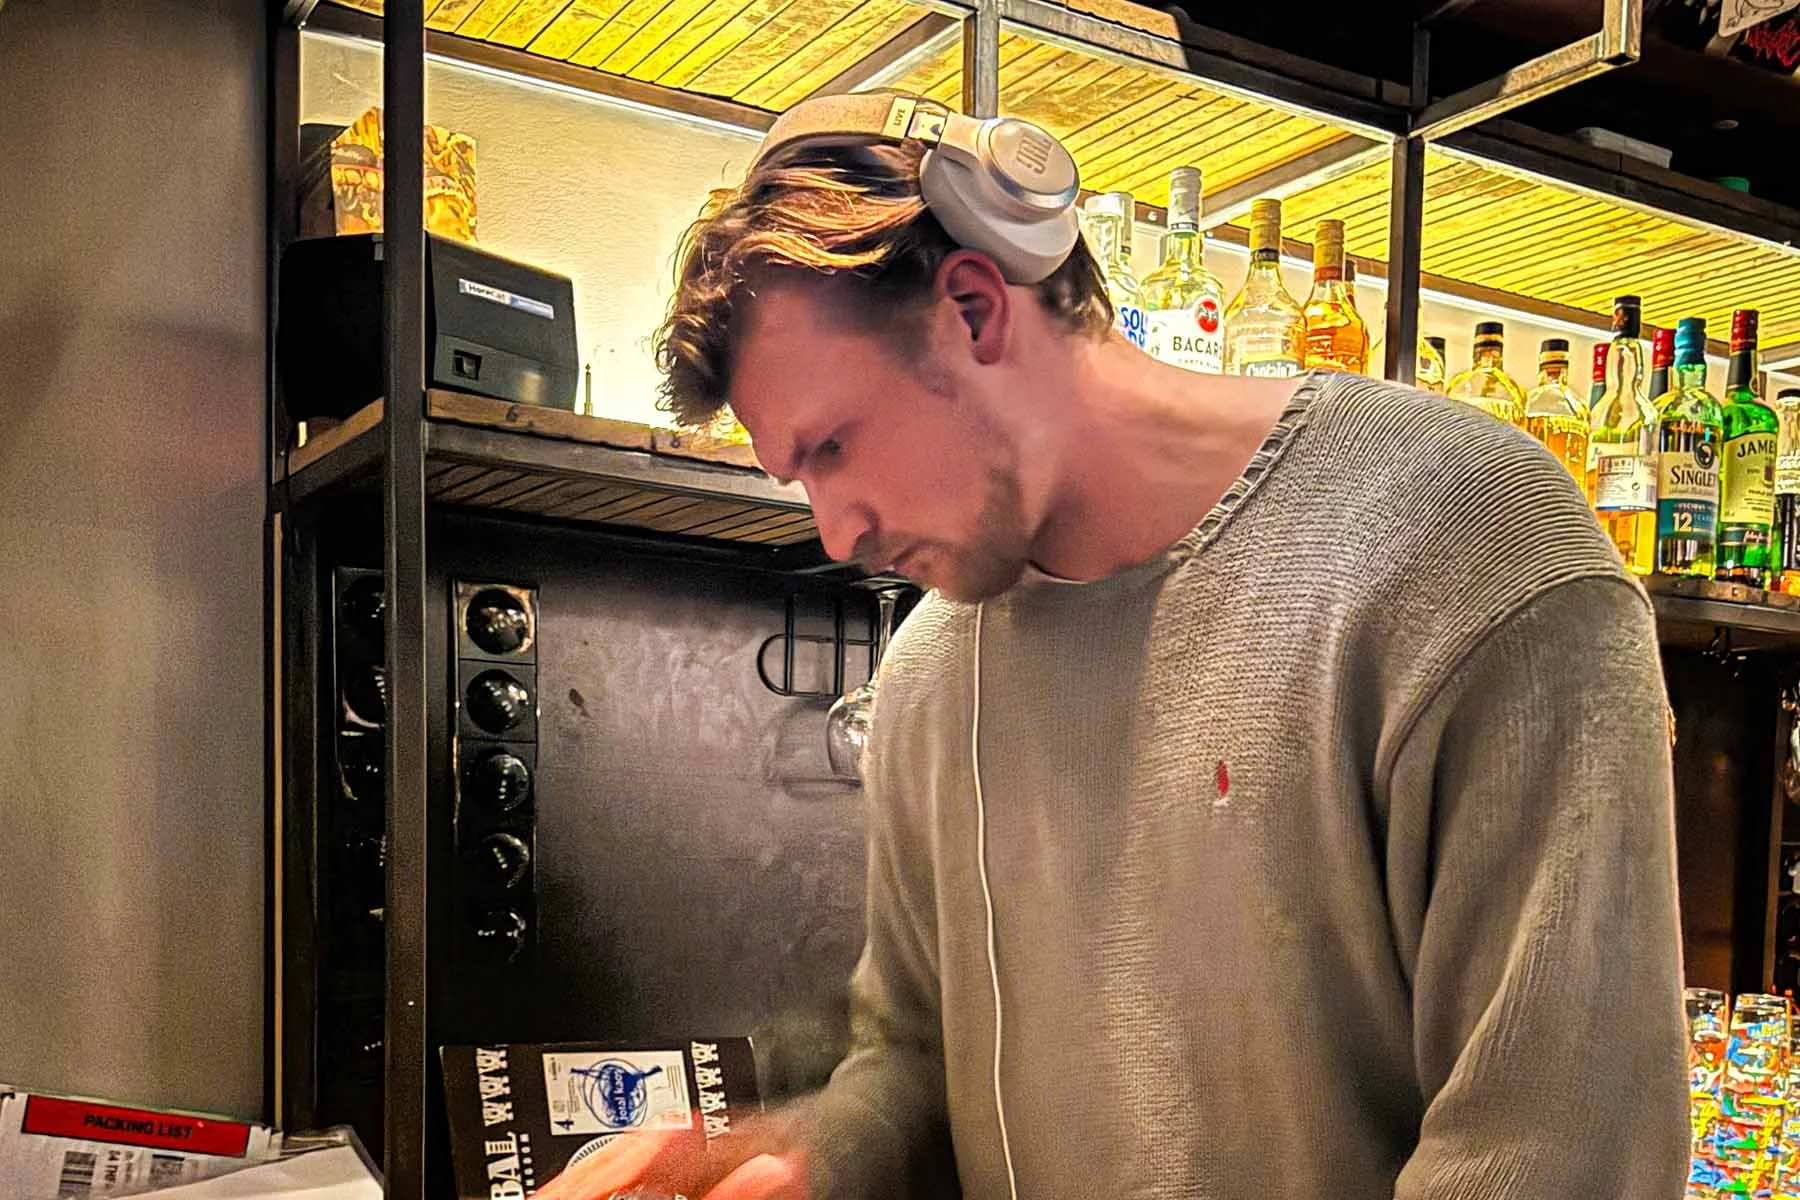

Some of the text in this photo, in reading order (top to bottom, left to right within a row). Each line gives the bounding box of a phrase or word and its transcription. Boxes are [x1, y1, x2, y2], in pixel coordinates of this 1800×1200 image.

[1016, 138, 1053, 175] JBL
[1737, 438, 1776, 458] JAME
[1673, 512, 1692, 532] 12
[82, 1113, 193, 1139] PACKING LIST
